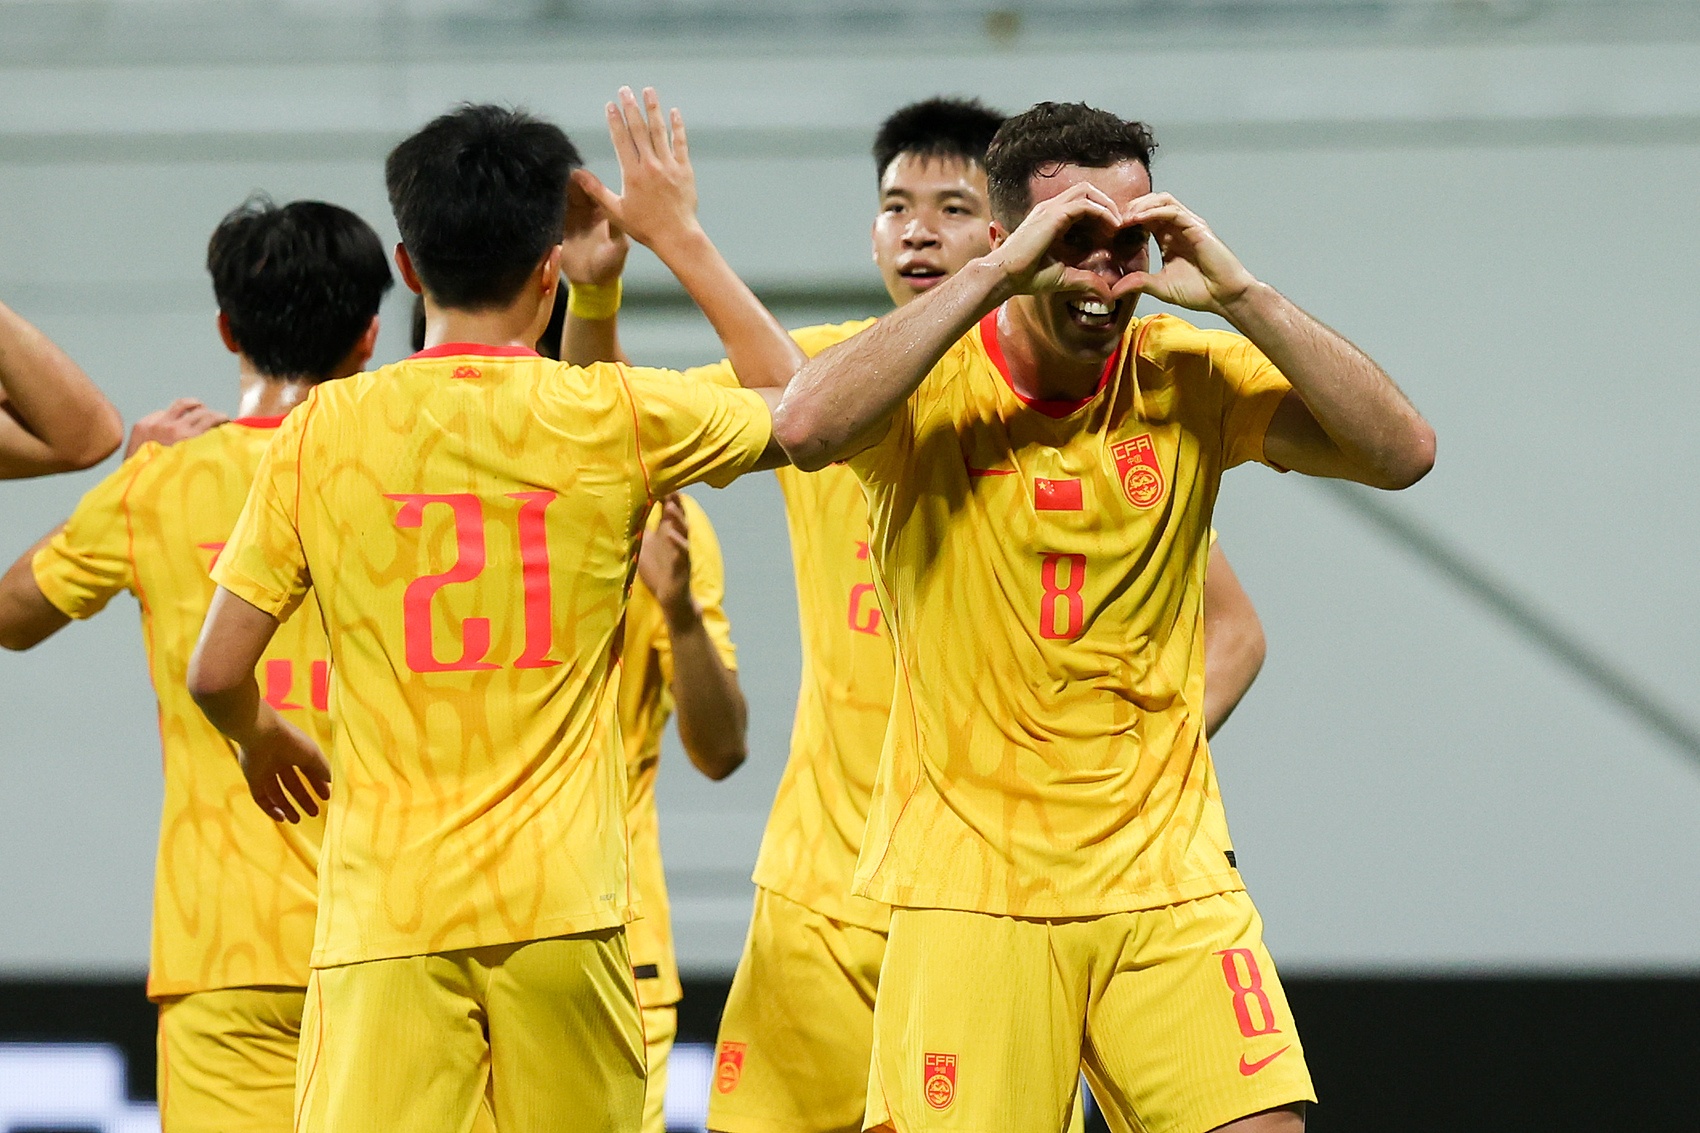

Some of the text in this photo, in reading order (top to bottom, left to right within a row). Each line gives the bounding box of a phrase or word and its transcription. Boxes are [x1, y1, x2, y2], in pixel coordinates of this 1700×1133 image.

[1113, 437, 1150, 461] CFA
[382, 491, 563, 673] 21
[1037, 551, 1087, 640] 8
[1212, 948, 1282, 1038] 8
[925, 1054, 956, 1067] CFA
